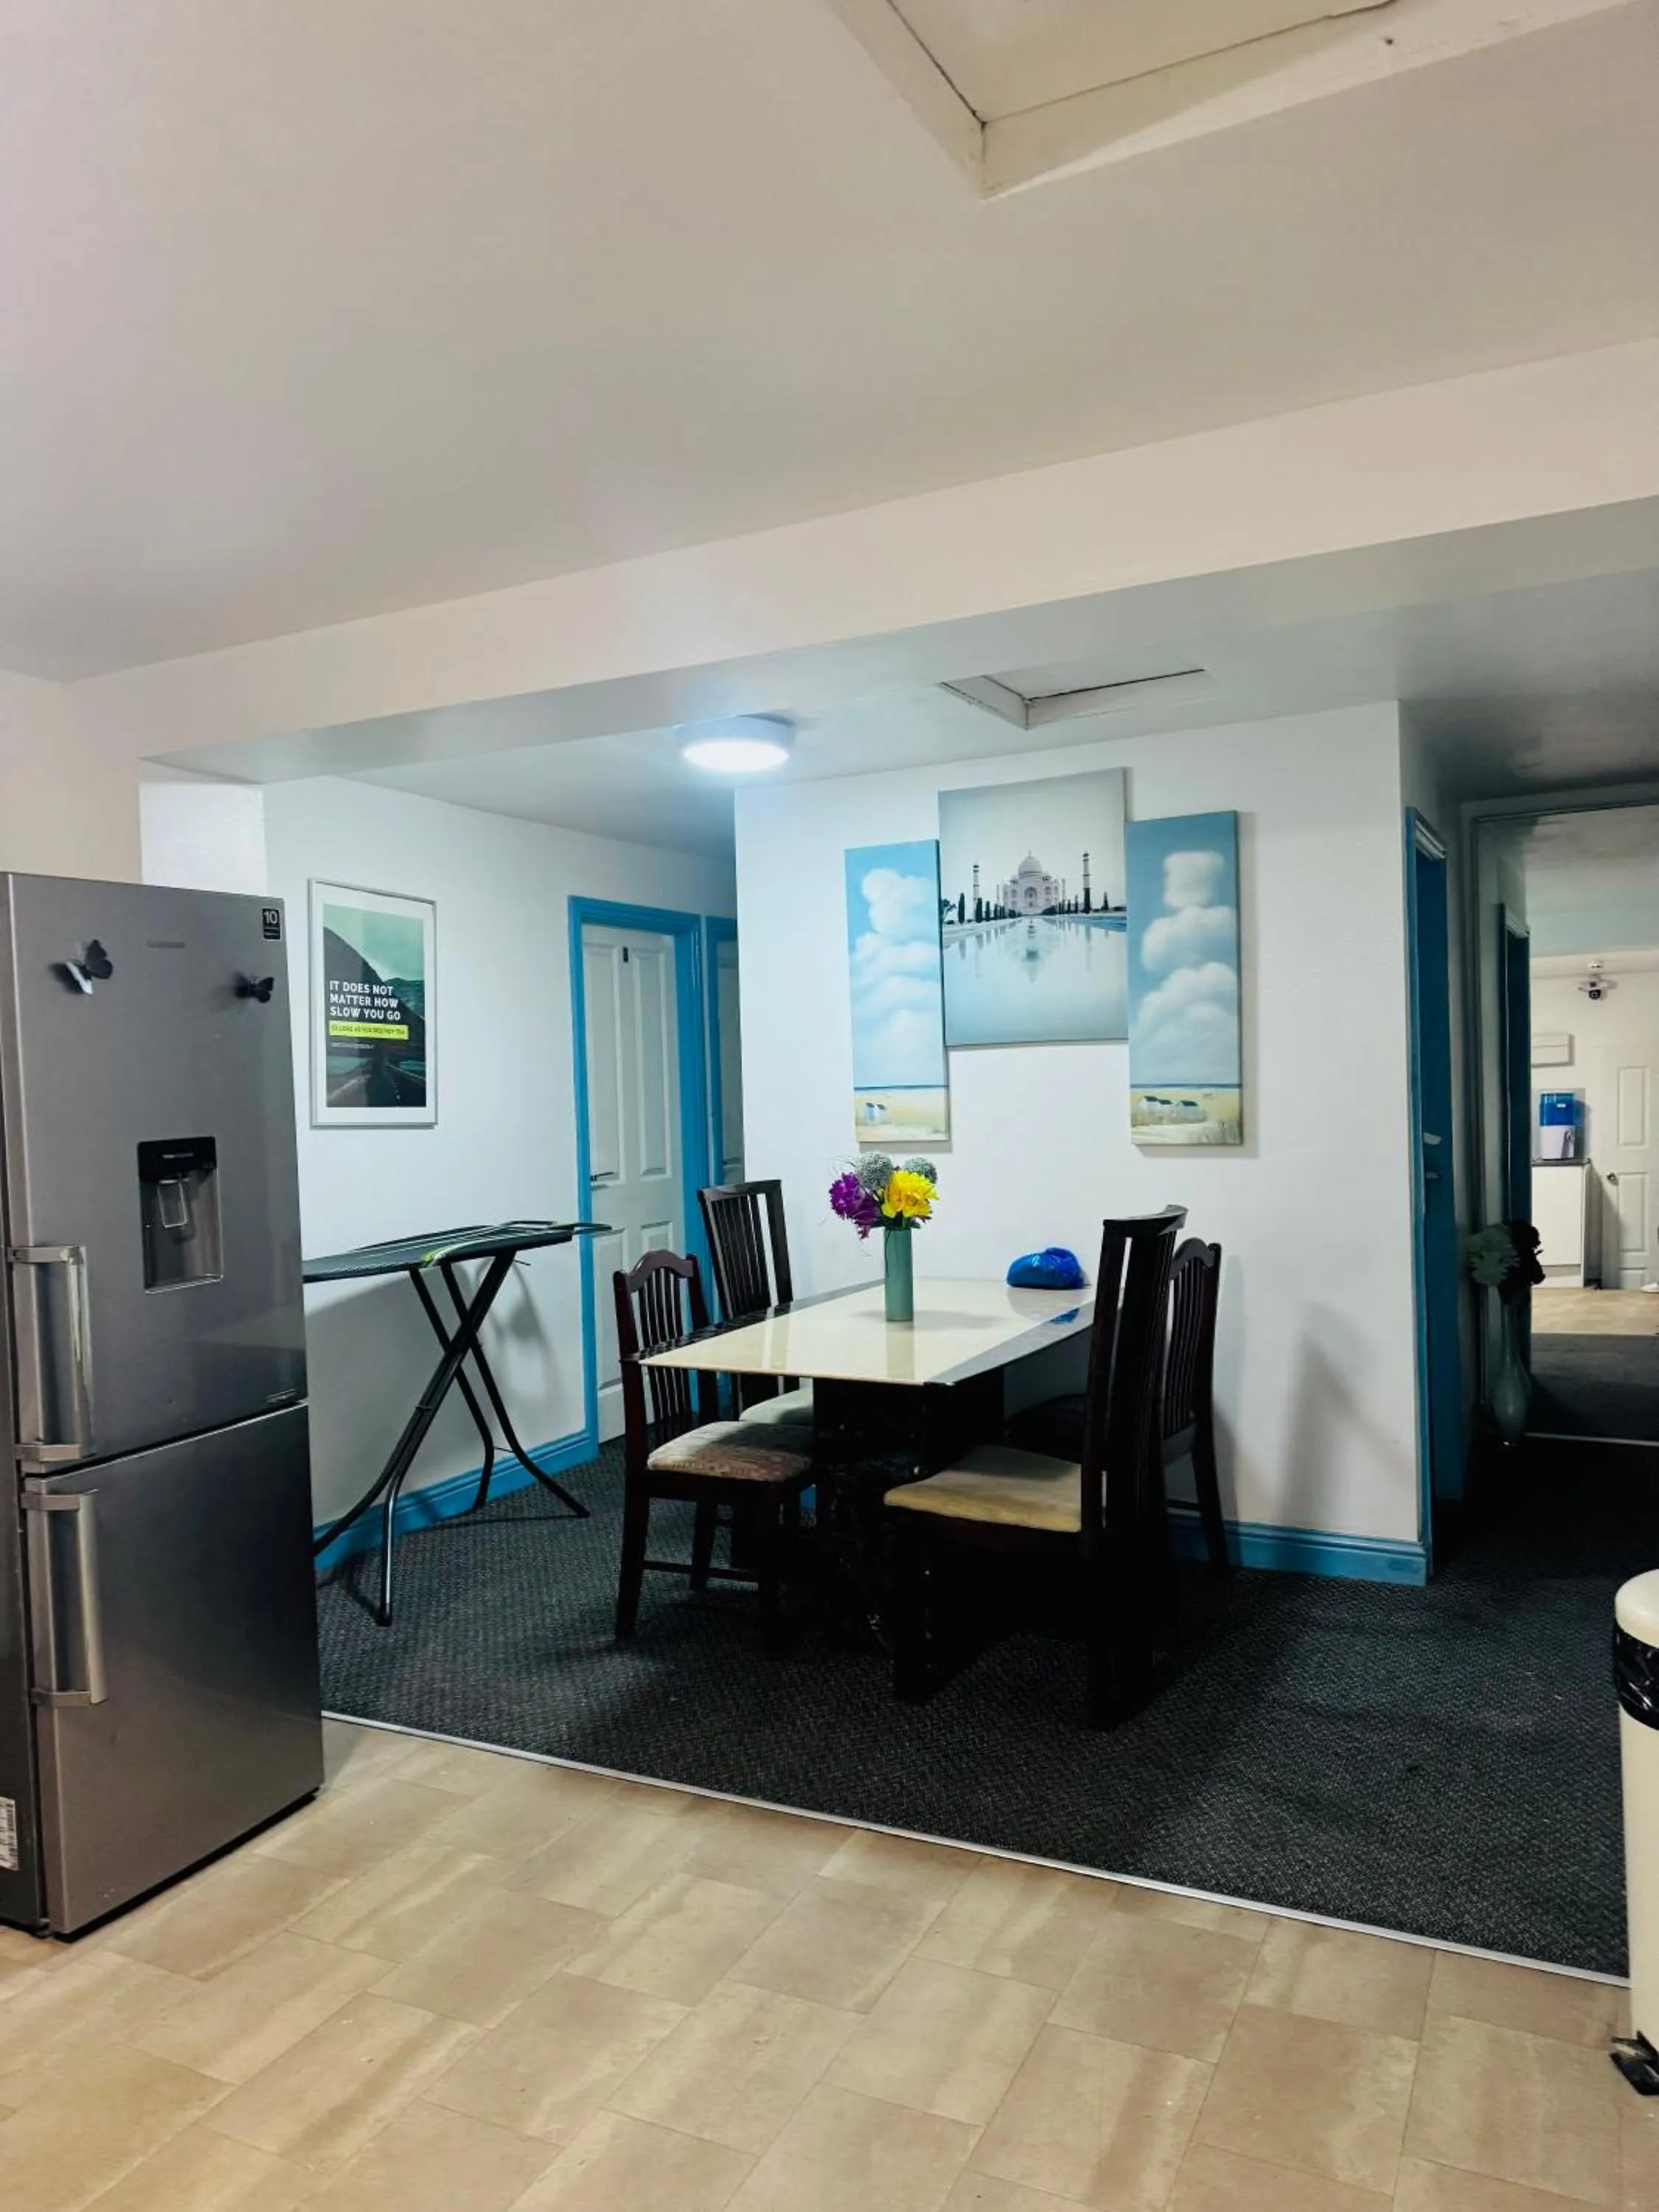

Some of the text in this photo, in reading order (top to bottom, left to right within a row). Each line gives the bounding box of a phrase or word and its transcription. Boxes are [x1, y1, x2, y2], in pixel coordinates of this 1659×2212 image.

[264, 911, 278, 924] 10
[330, 980, 394, 995] IT DOES NOT
[330, 993, 399, 1008] MATTER HOW
[330, 1006, 401, 1020] SLOW YOU GO
